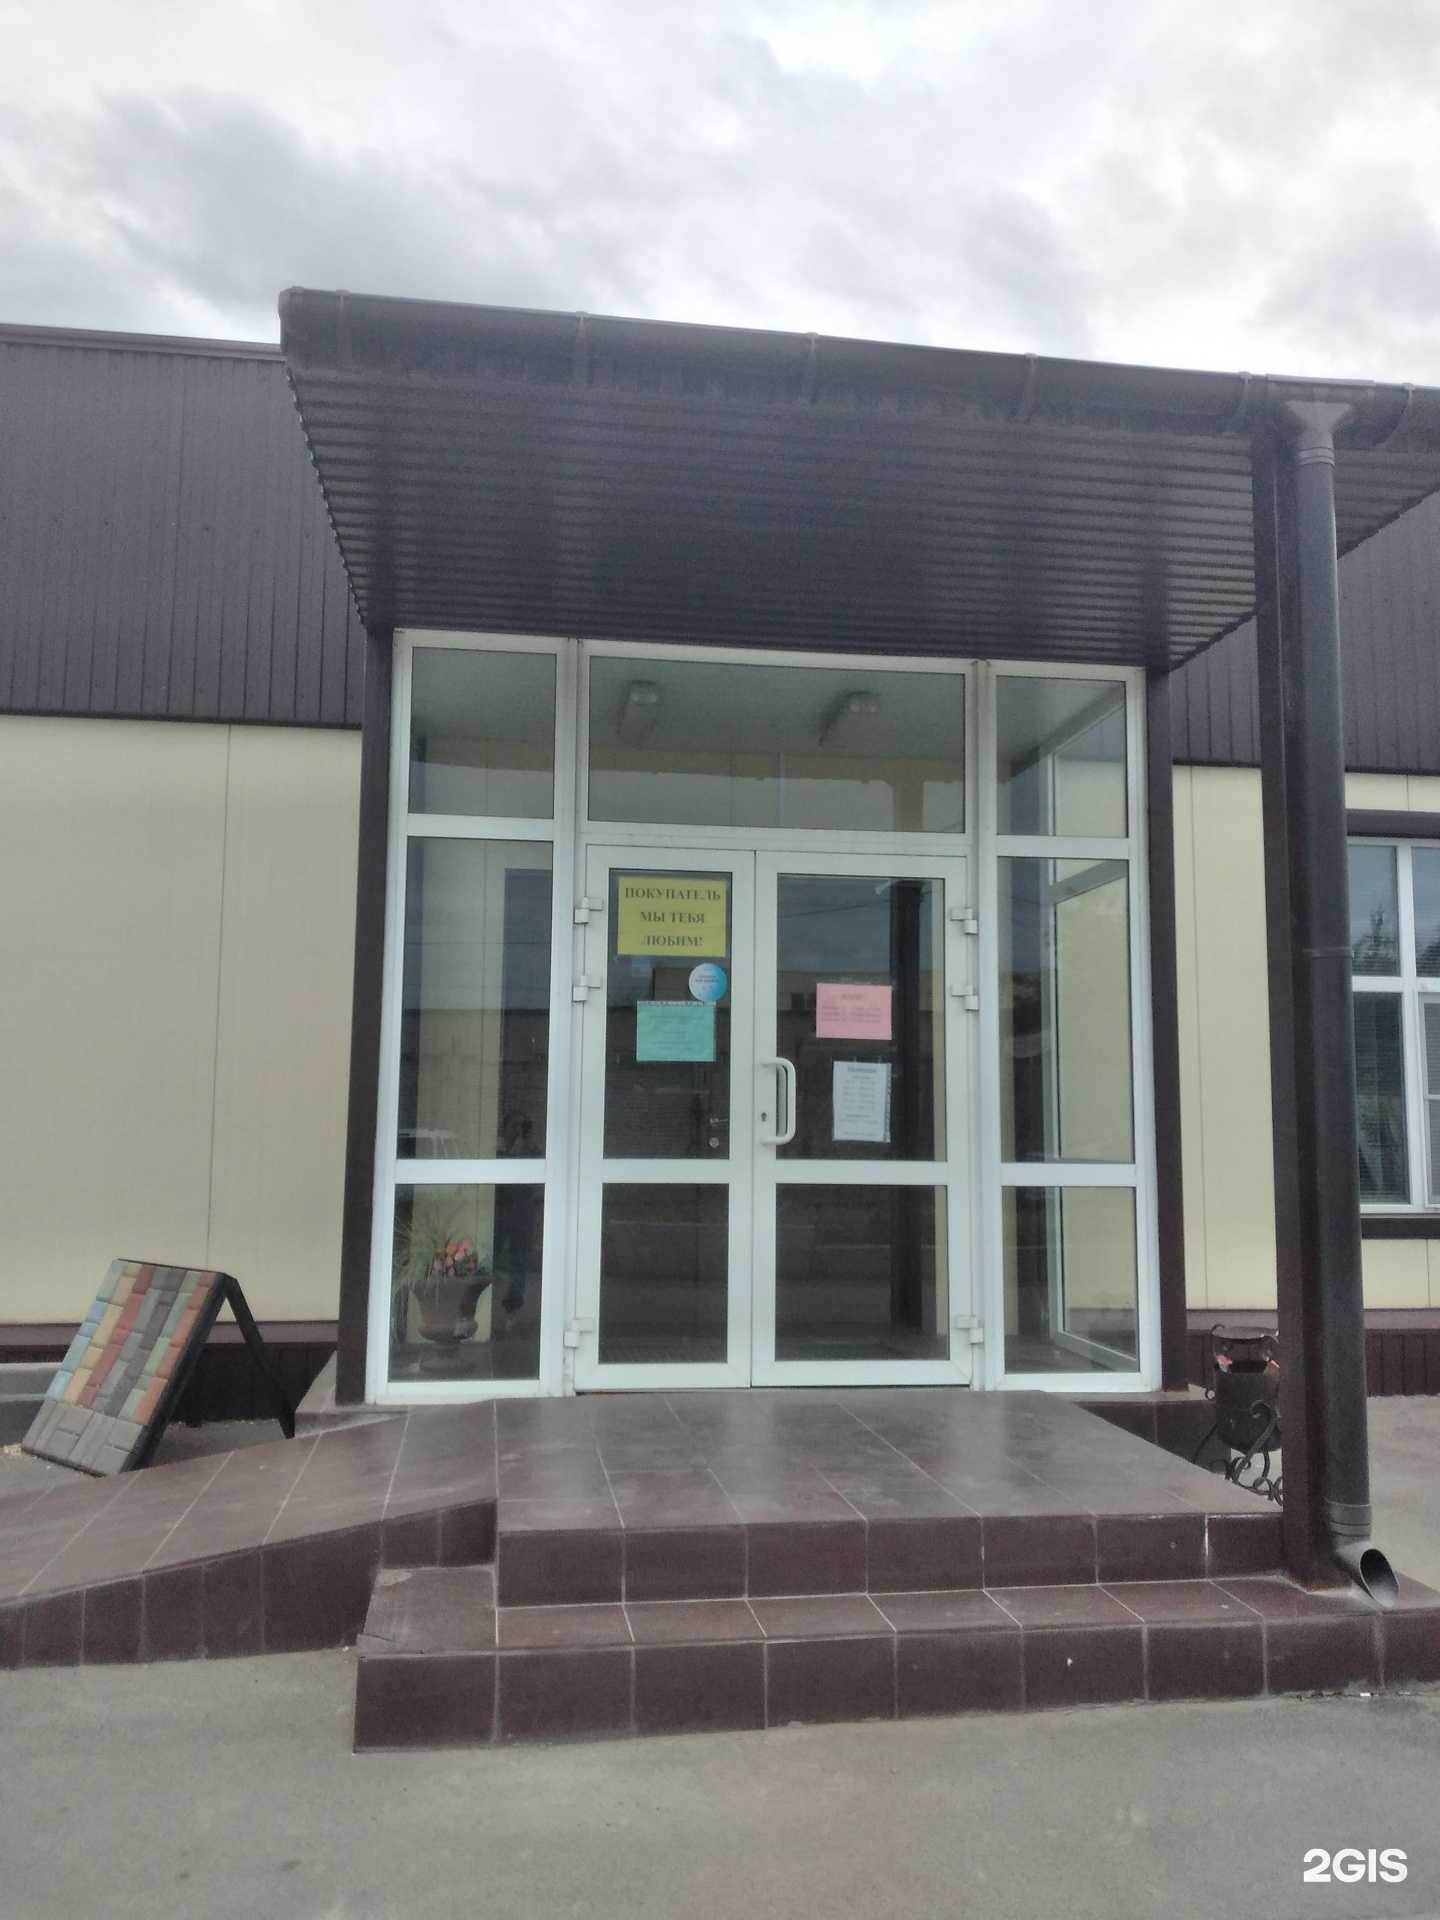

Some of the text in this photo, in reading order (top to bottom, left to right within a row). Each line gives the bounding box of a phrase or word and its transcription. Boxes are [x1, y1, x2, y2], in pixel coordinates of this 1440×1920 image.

[625, 887, 721, 901] ПОКУПАТЕЛЬ
[640, 911, 705, 924] МЫ ТЕБЯ
